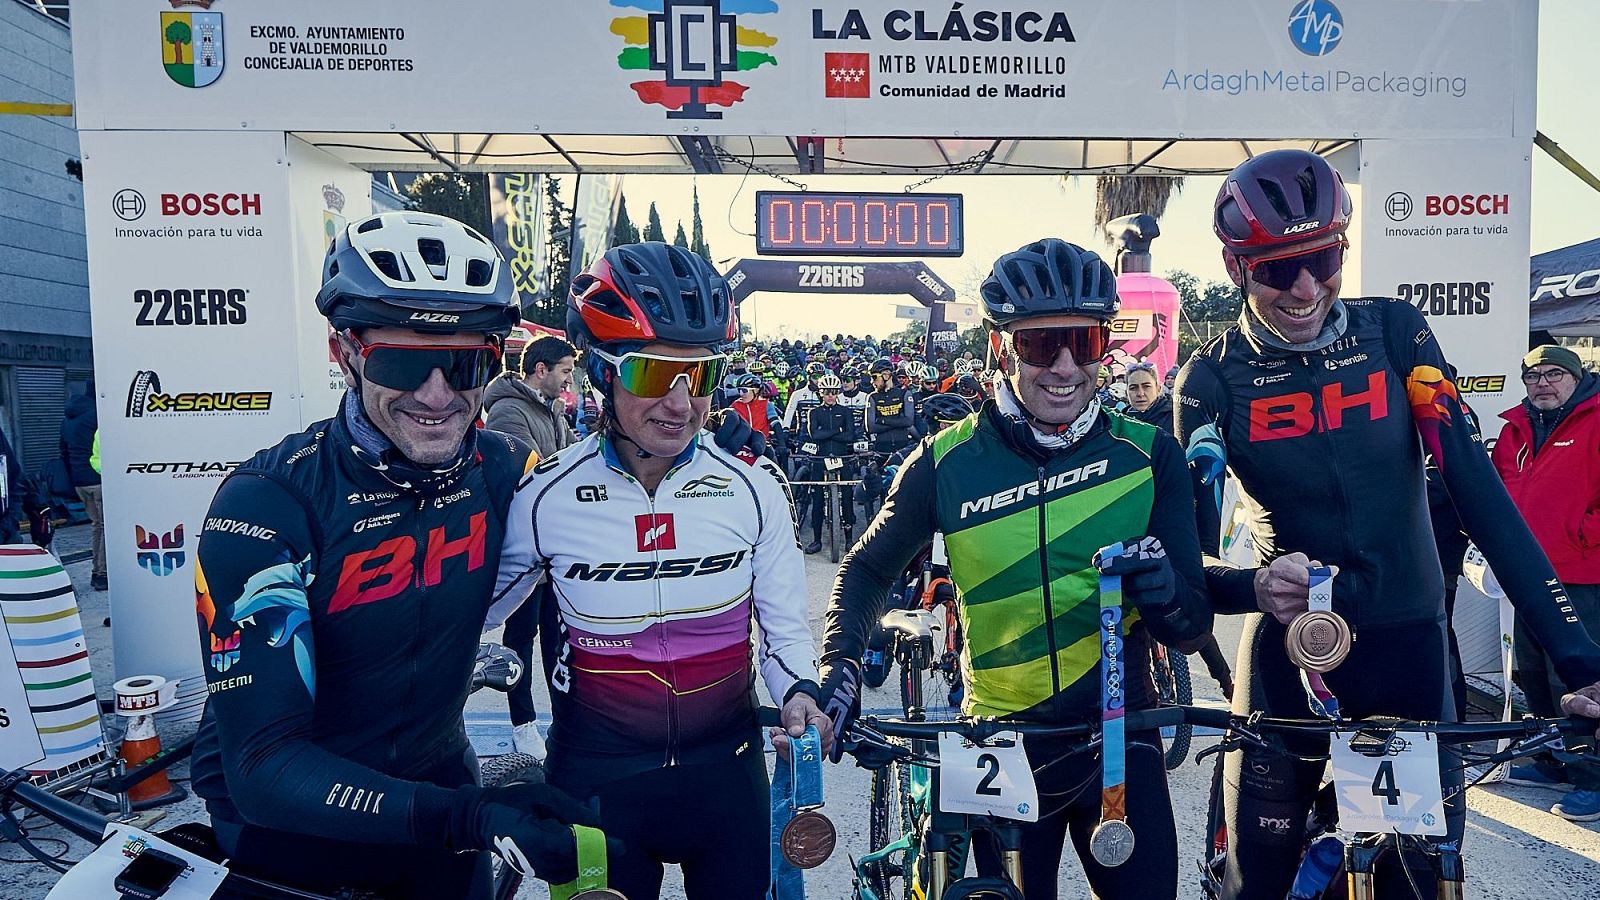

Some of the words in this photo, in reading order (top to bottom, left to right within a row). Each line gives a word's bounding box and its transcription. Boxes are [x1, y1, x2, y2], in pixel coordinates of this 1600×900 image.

[812, 9, 871, 40] LA
[884, 2, 1076, 42] CLÁSICA
[250, 26, 299, 39] EXCMO.
[306, 27, 405, 40] AYUNTAMIENTO
[269, 41, 286, 54] DE
[289, 42, 388, 56] VALDEMORILLO
[244, 57, 324, 70] CONCEJALIA
[328, 58, 345, 70] DE
[348, 58, 413, 72] DEPORTES
[879, 55, 916, 74] MTB
[926, 56, 1066, 75] VALDEMORILLO
[879, 84, 970, 98] Comunidad
[976, 83, 998, 98] de
[1004, 84, 1066, 98] Madrid
[161, 193, 261, 216] BOSCH
[1425, 194, 1509, 216] BOSCH
[115, 226, 183, 237] Innovación
[188, 229, 216, 239] para
[220, 227, 232, 237] tu
[236, 226, 263, 237] vida
[1284, 221, 1320, 235] LAZER
[1385, 225, 1443, 237] Innovación
[1447, 227, 1469, 238] para
[1472, 226, 1482, 235] tu
[1485, 224, 1508, 235] vida
[799, 265, 864, 287] 226ERS
[916, 271, 945, 296] 226ERS
[134, 289, 247, 326] 226ERS
[410, 312, 460, 323] LAZER
[1338, 352, 1368, 367] sentis
[147, 392, 272, 411] X-SAUCE
[1249, 369, 1389, 442] BH
[674, 490, 735, 499] Gardenhotels
[960, 459, 1109, 519] MERIDA
[205, 517, 277, 541] CHAOYANG
[327, 511, 487, 614] BH
[1545, 578, 1578, 623] GOBIK
[1107, 620, 1117, 651] ATHENS
[1108, 652, 1117, 672] 2004
[119, 694, 157, 709] MTB
[976, 753, 1001, 796] 2
[1372, 761, 1400, 805] 4
[326, 783, 384, 814] GOBIK
[1259, 816, 1290, 829] FOX
